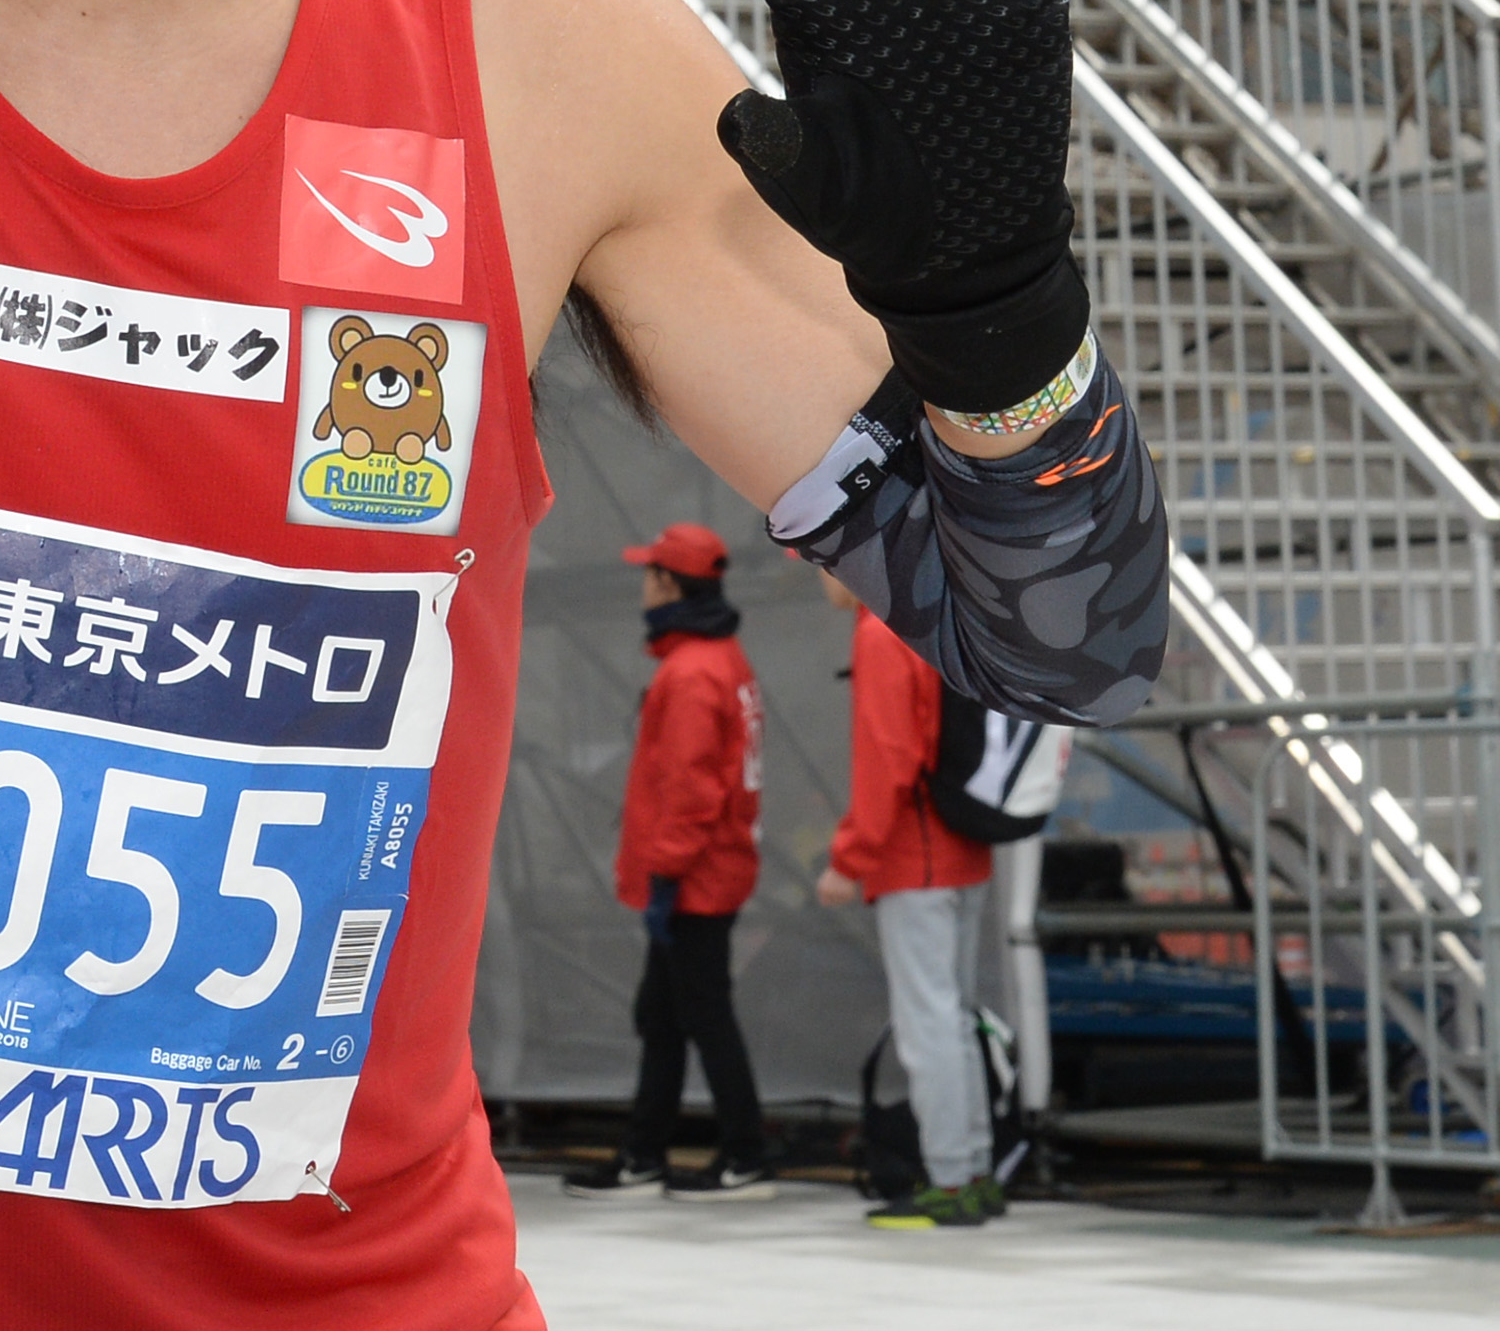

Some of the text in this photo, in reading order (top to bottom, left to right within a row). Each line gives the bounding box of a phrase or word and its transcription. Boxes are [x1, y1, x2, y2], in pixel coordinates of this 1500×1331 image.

[324, 465, 433, 499] Round 87
[854, 473, 871, 490] S
[358, 781, 389, 881] KUNIAKI TAKIZAKI
[380, 803, 413, 869] A8055
[150, 1046, 213, 1072] Baggage
[216, 1054, 240, 1071] Car
[242, 1054, 262, 1071] No.
